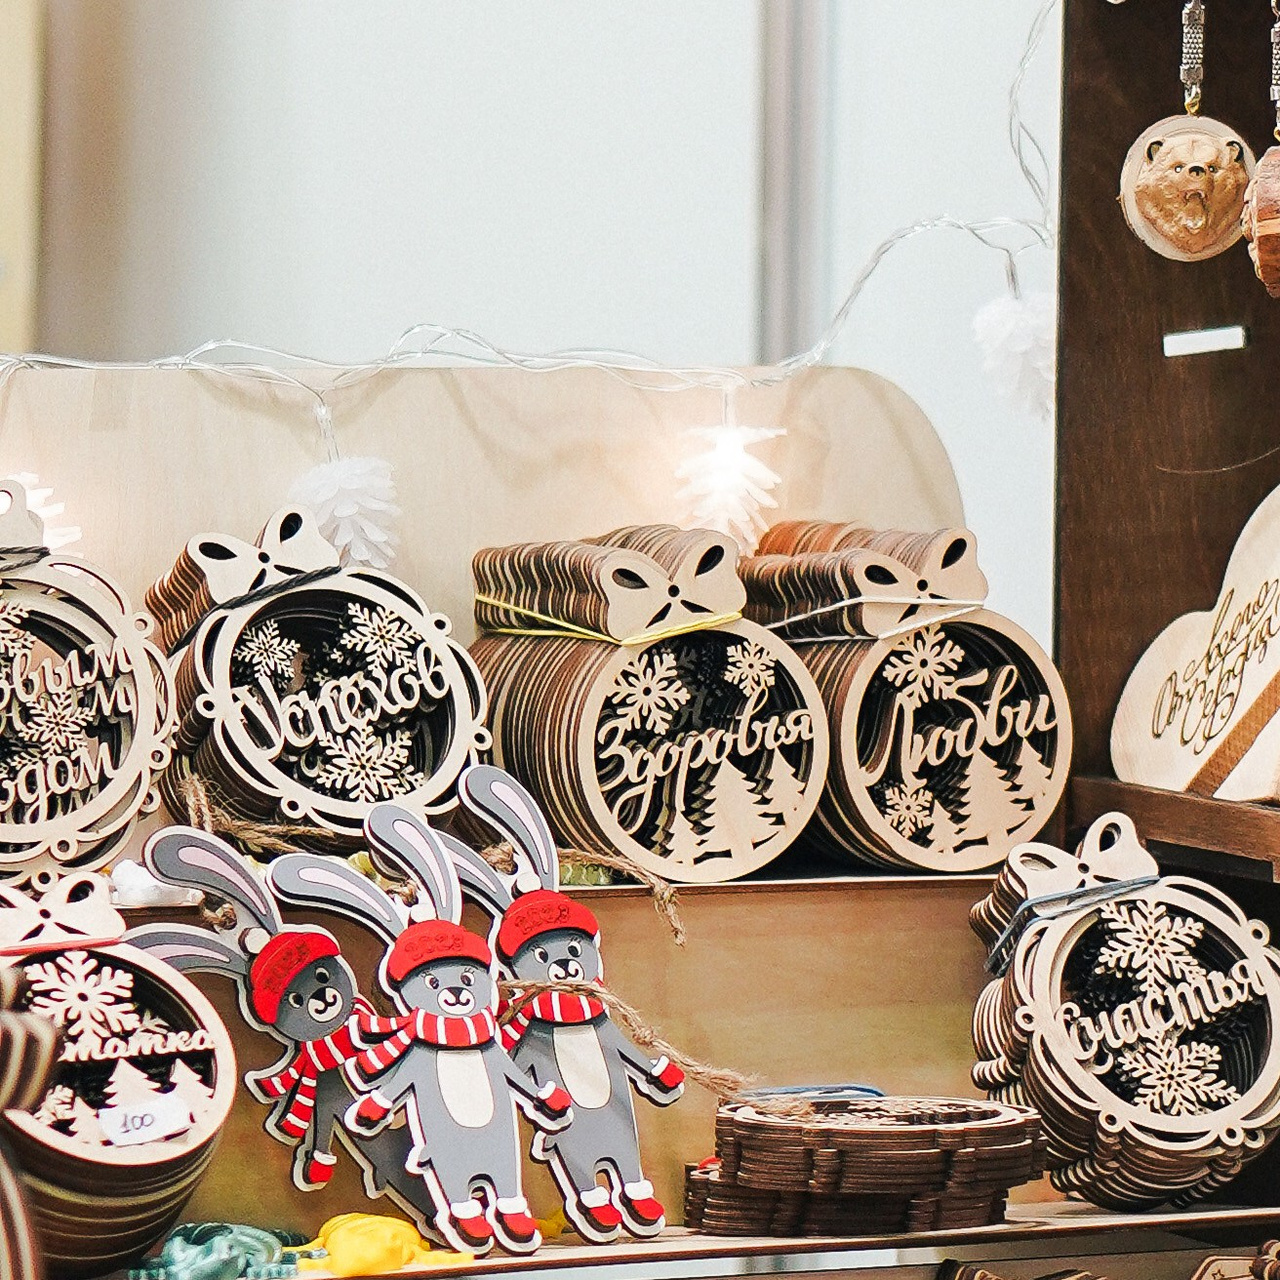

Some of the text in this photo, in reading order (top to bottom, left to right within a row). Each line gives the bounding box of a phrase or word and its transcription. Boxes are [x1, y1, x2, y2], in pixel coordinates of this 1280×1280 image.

[233, 641, 451, 761] Успехов
[598, 686, 815, 832] Здоровья
[858, 665, 1059, 788] Любви
[1055, 958, 1267, 1066] Счастья
[119, 1112, 155, 1134] 100
